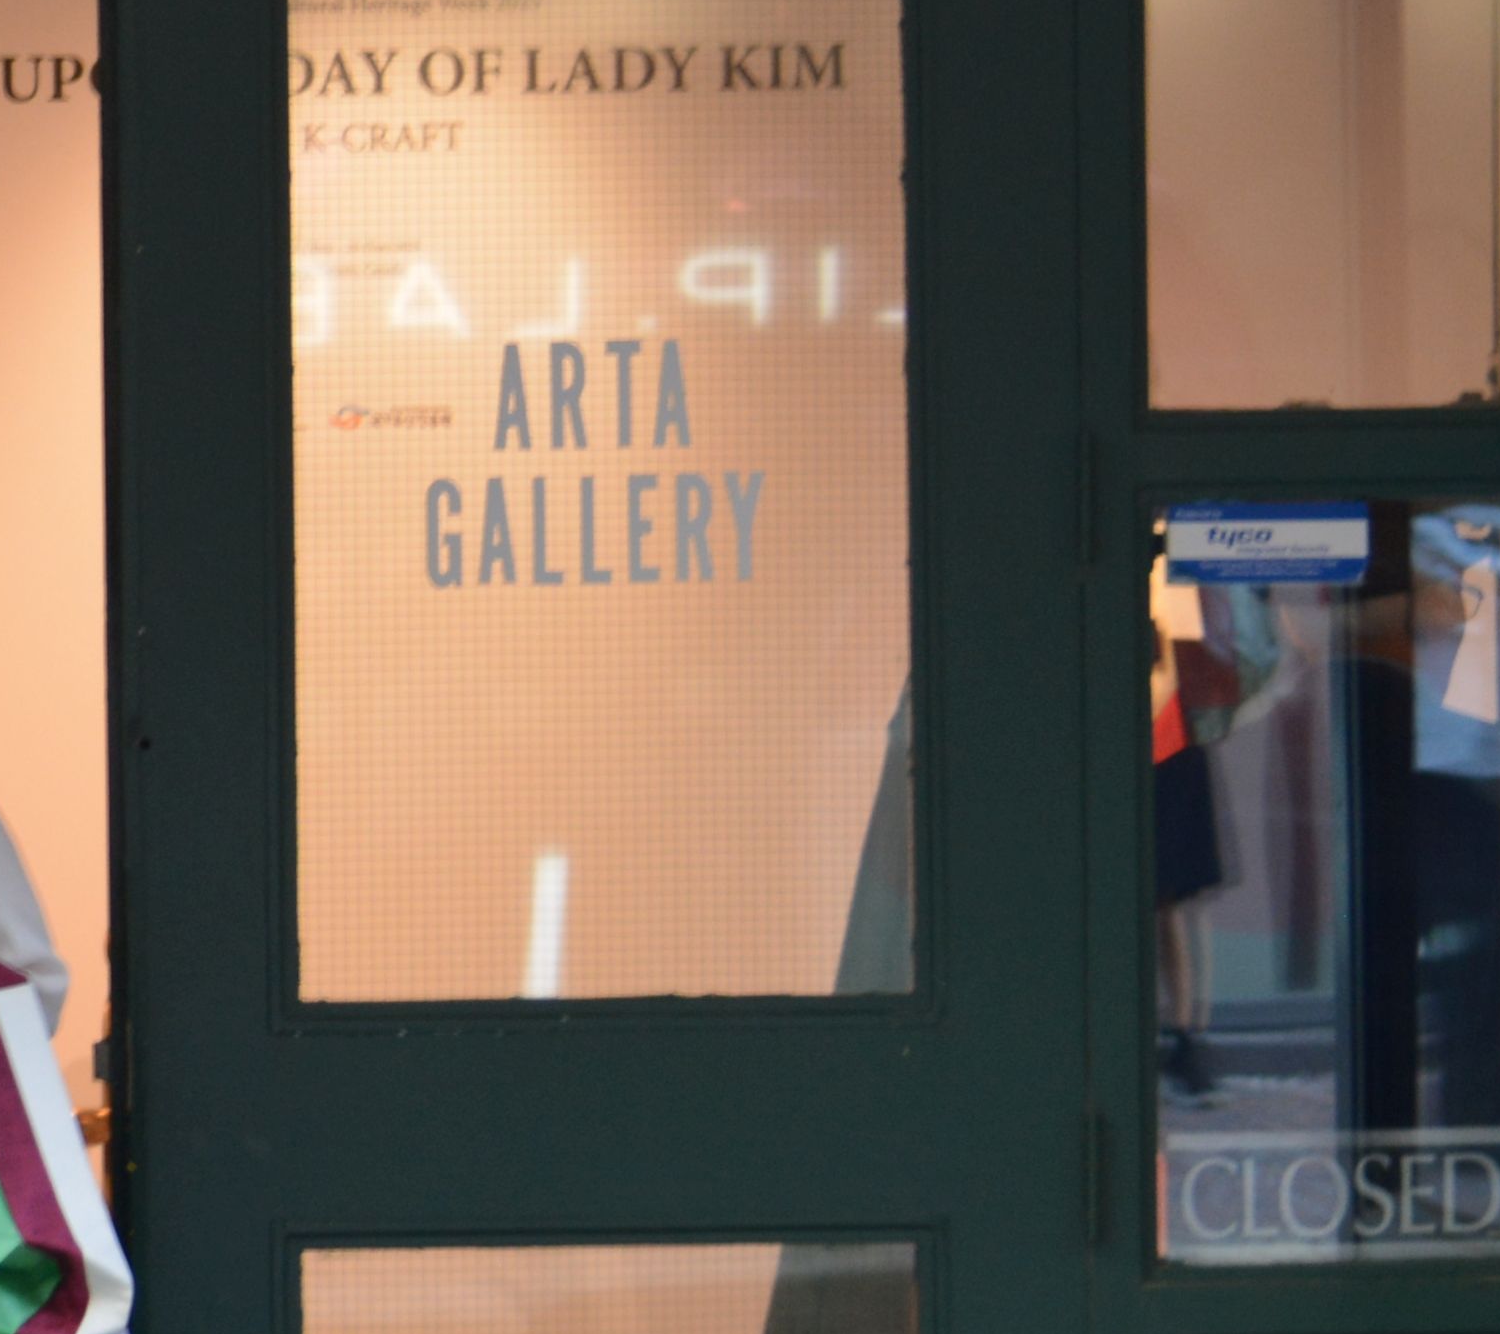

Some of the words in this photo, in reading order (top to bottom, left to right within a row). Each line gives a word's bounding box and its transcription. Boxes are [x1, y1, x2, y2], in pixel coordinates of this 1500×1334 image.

[1, 54, 101, 105] UP
[419, 45, 505, 95] OF
[523, 42, 700, 95] LADY
[720, 42, 846, 91] KIM
[493, 338, 692, 451] ARTA
[424, 470, 767, 590] GALLERY
[1206, 524, 1274, 550] tyco
